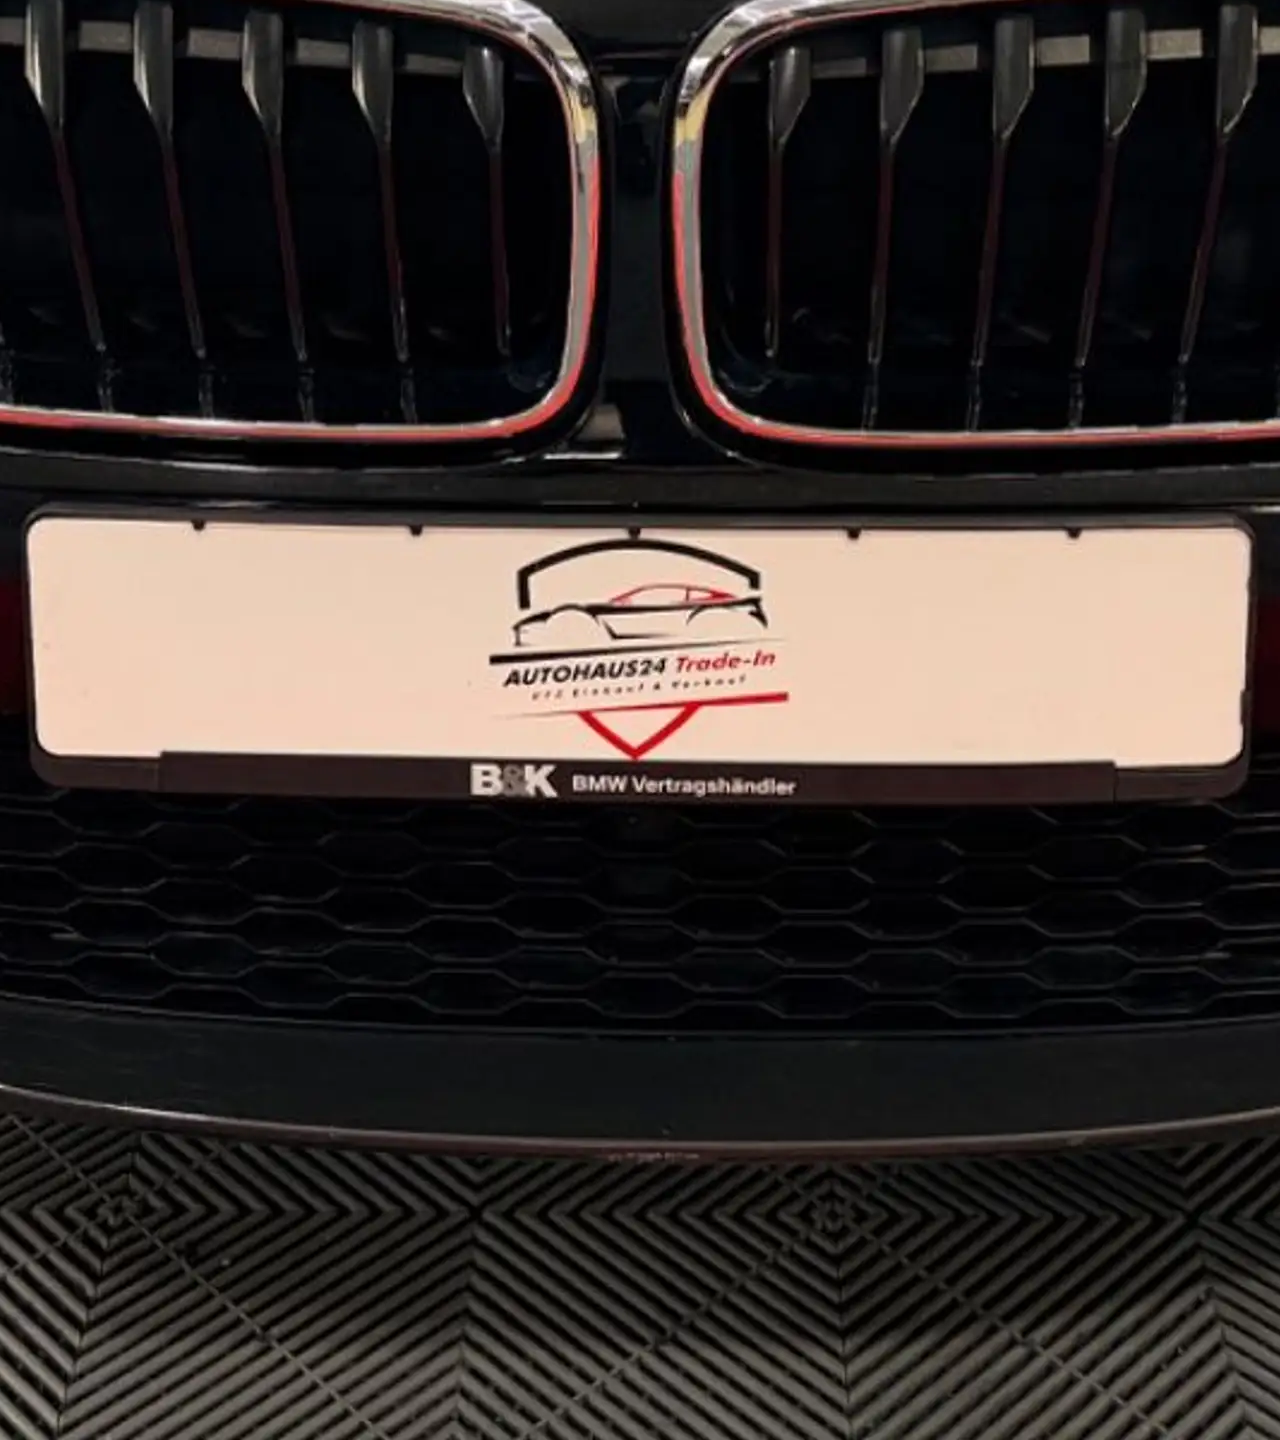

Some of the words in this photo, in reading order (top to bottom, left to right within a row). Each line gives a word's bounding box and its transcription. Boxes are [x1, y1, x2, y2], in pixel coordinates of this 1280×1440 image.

[503, 658, 666, 687] AUTOHAUS24
[676, 649, 776, 673] Trade-In
[471, 763, 558, 798] B&K
[572, 773, 628, 793] BMW
[631, 775, 797, 798] Vertragshändler
